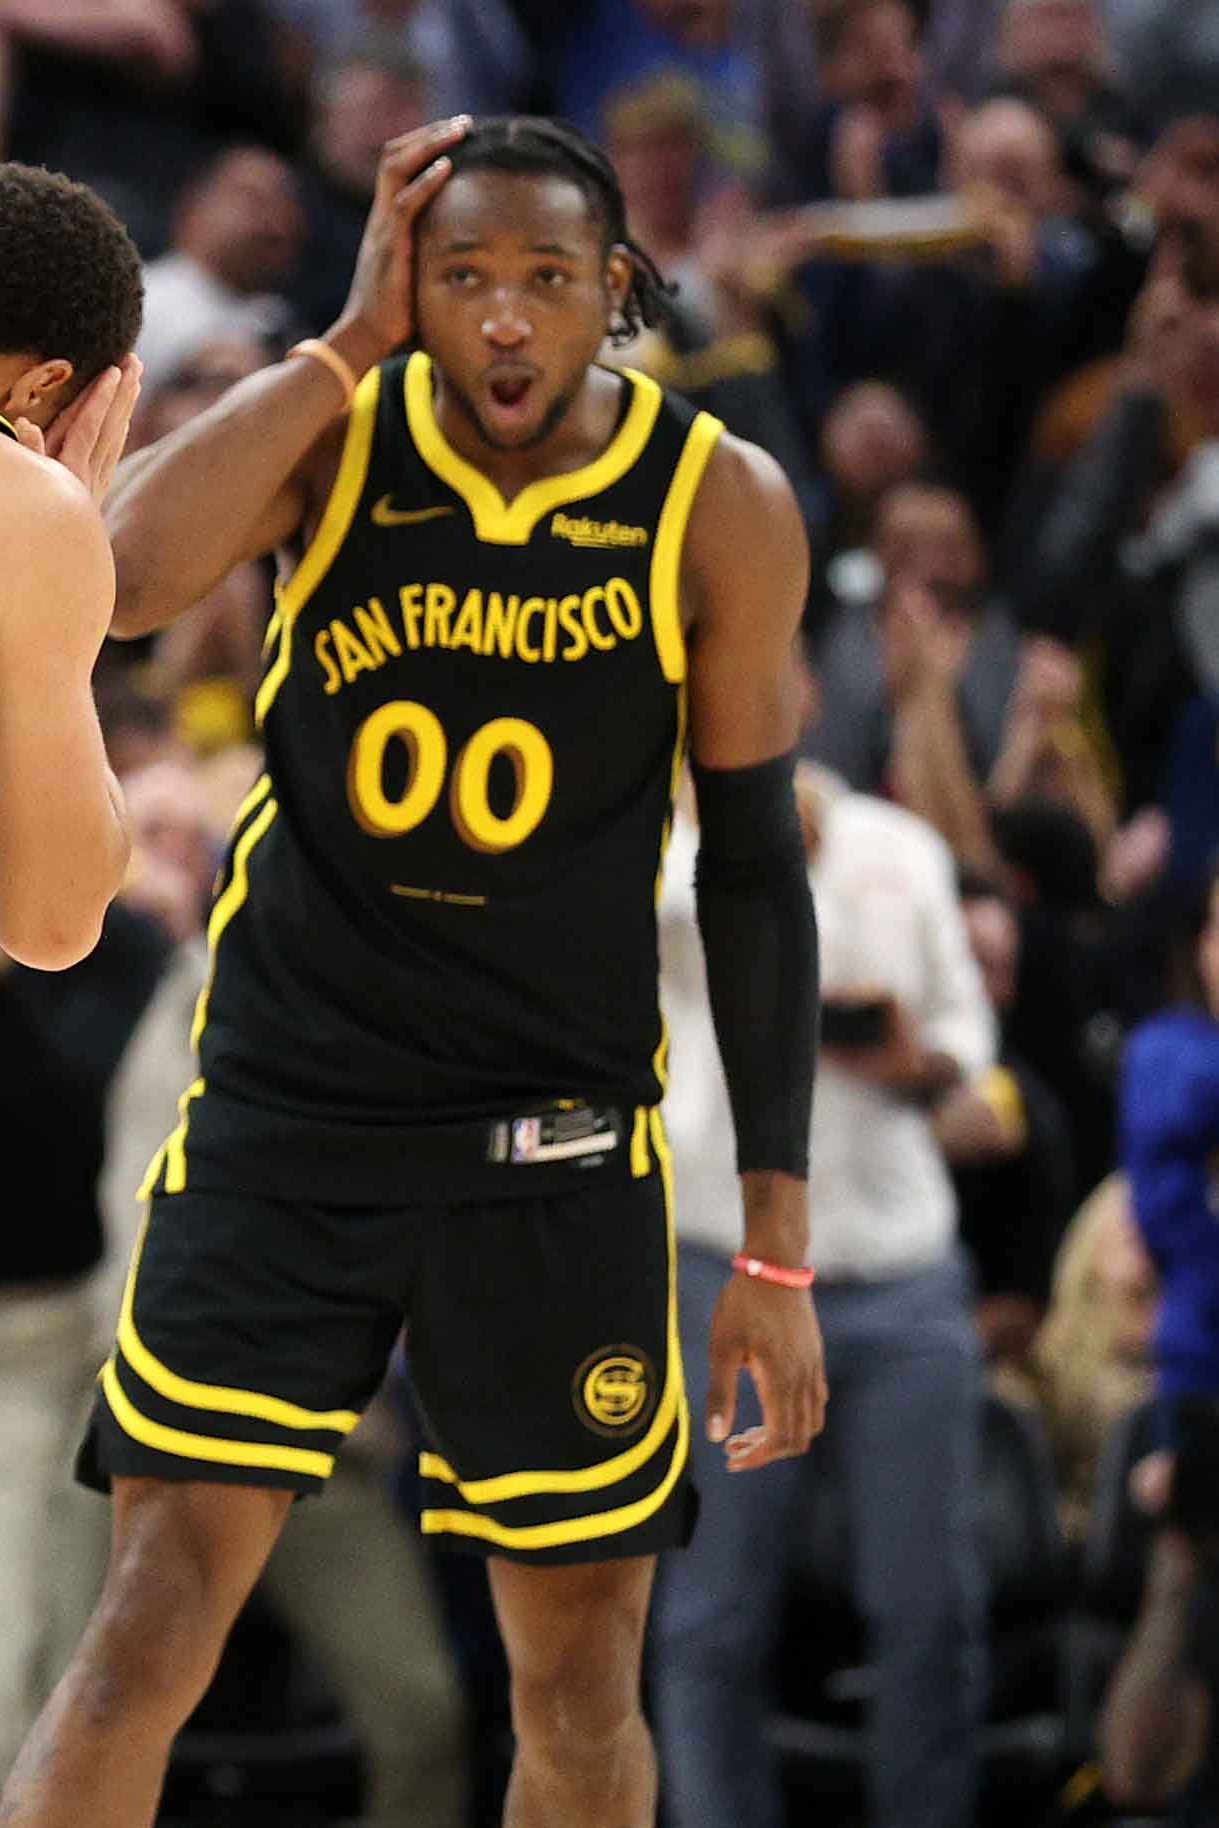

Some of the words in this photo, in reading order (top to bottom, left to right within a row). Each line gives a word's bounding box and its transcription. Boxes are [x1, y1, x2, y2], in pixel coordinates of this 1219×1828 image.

[550, 512, 648, 548] Rakuten
[314, 597, 402, 695] SAN
[399, 577, 642, 663] FRANCISCO
[346, 700, 554, 855] 00
